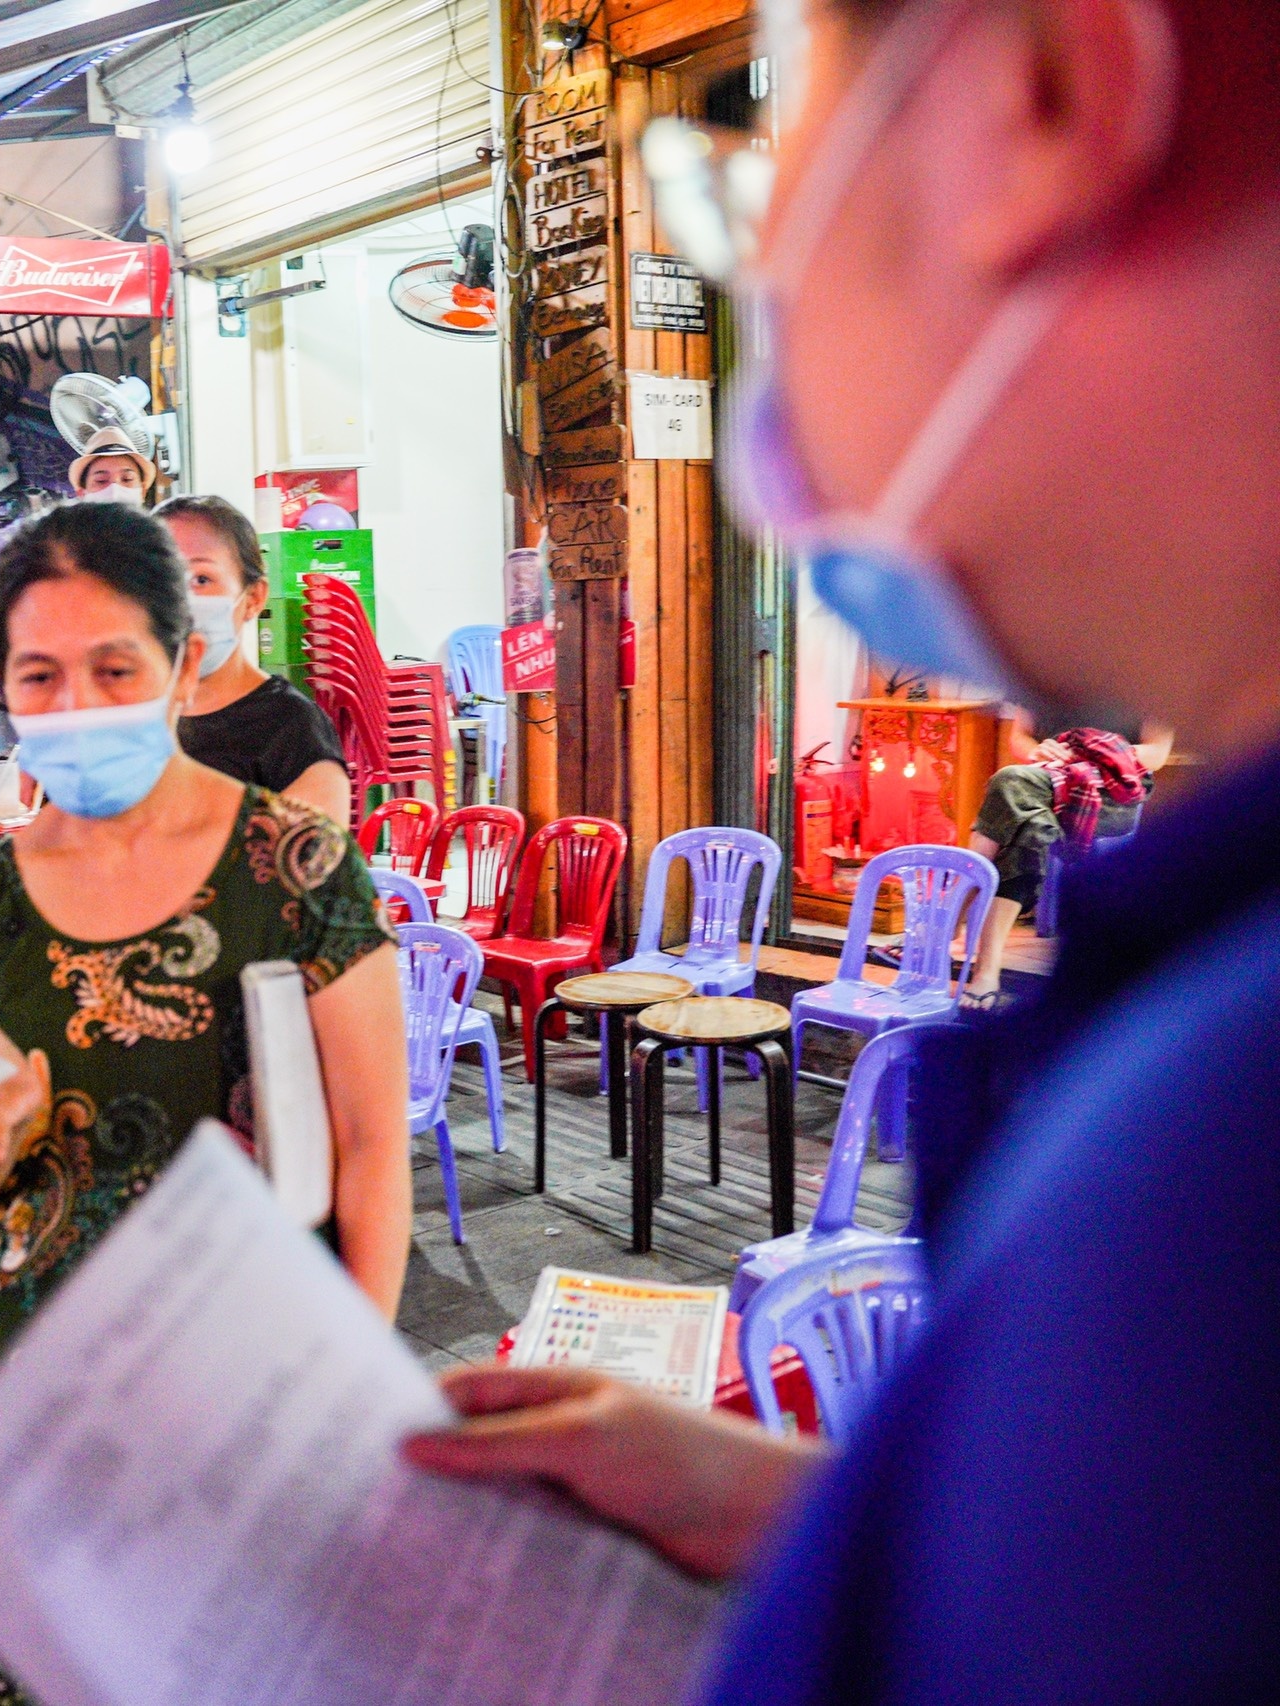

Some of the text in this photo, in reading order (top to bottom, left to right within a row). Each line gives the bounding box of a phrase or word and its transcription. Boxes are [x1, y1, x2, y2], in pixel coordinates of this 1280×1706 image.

[537, 81, 597, 120] ROOM
[667, 418, 682, 432] 4G
[548, 508, 617, 543] CAR
[507, 630, 545, 657] LÊN
